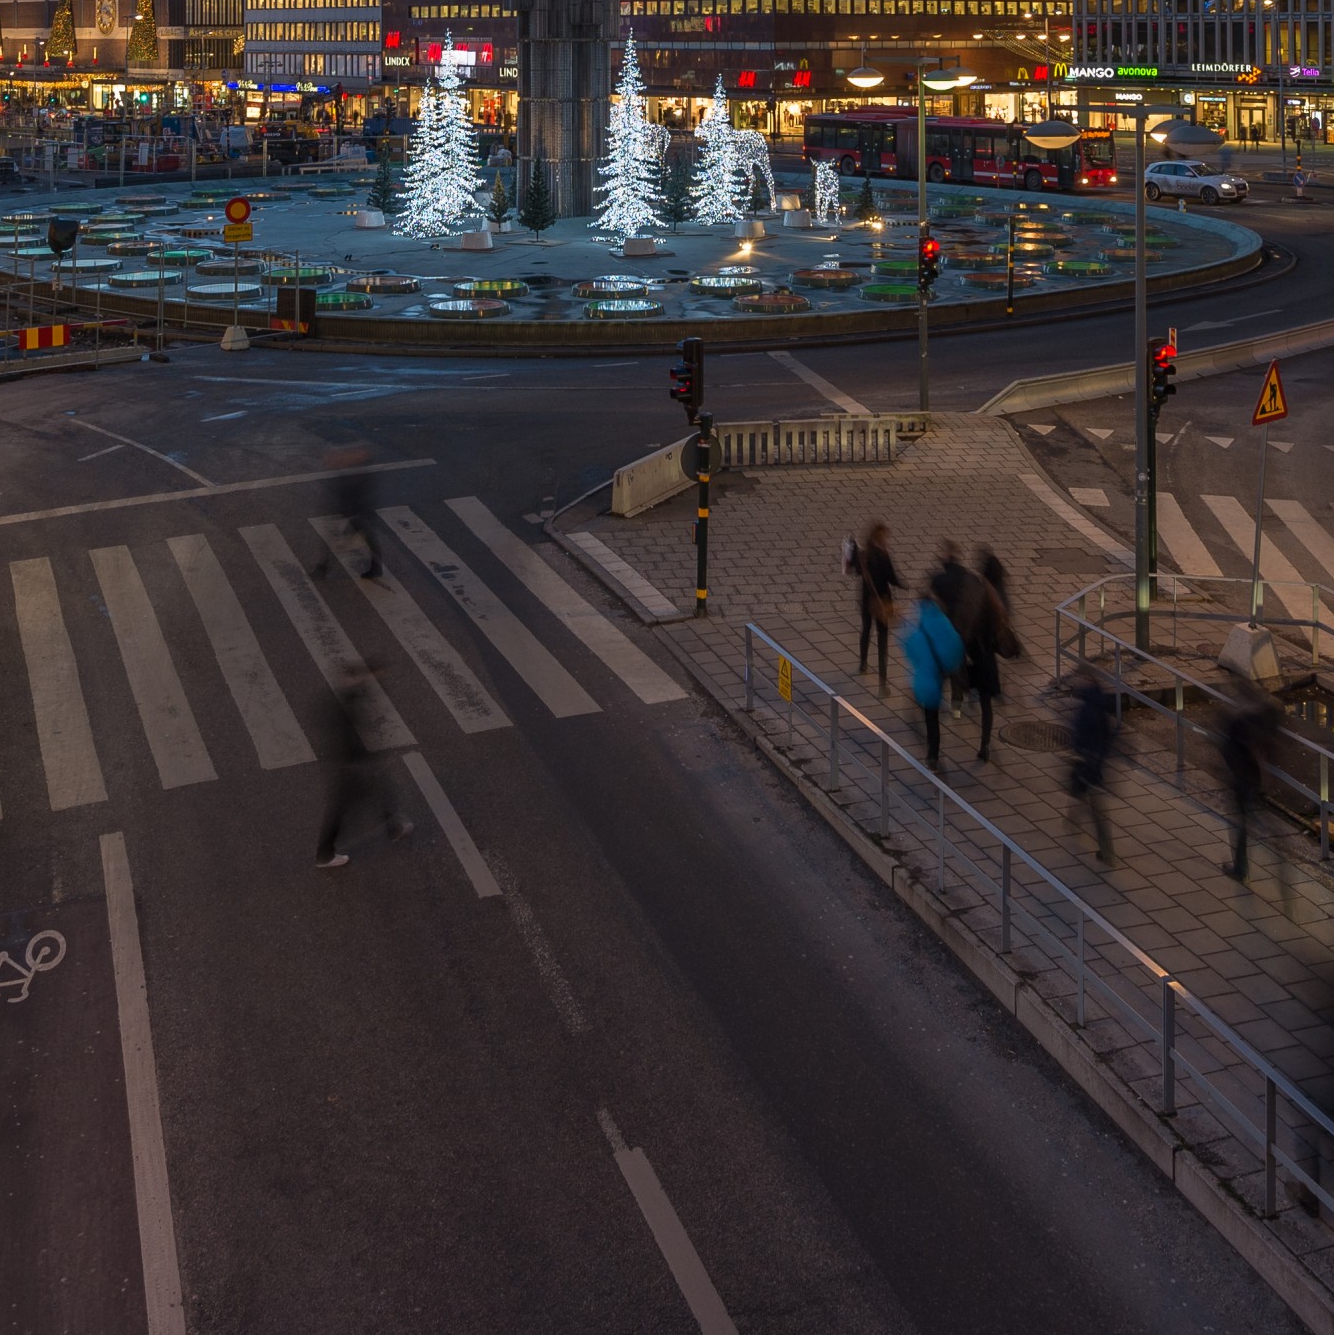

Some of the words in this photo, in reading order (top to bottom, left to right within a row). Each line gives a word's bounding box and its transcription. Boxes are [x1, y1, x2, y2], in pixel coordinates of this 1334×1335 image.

[384, 56, 410, 67] LINDEX
[499, 67, 518, 78] LIND
[1069, 67, 1115, 78] MANGO
[1117, 66, 1158, 77] avonova
[1191, 62, 1253, 73] LEIMDÖRFER
[1301, 68, 1320, 77] Telia
[1115, 93, 1143, 101] MANGO
